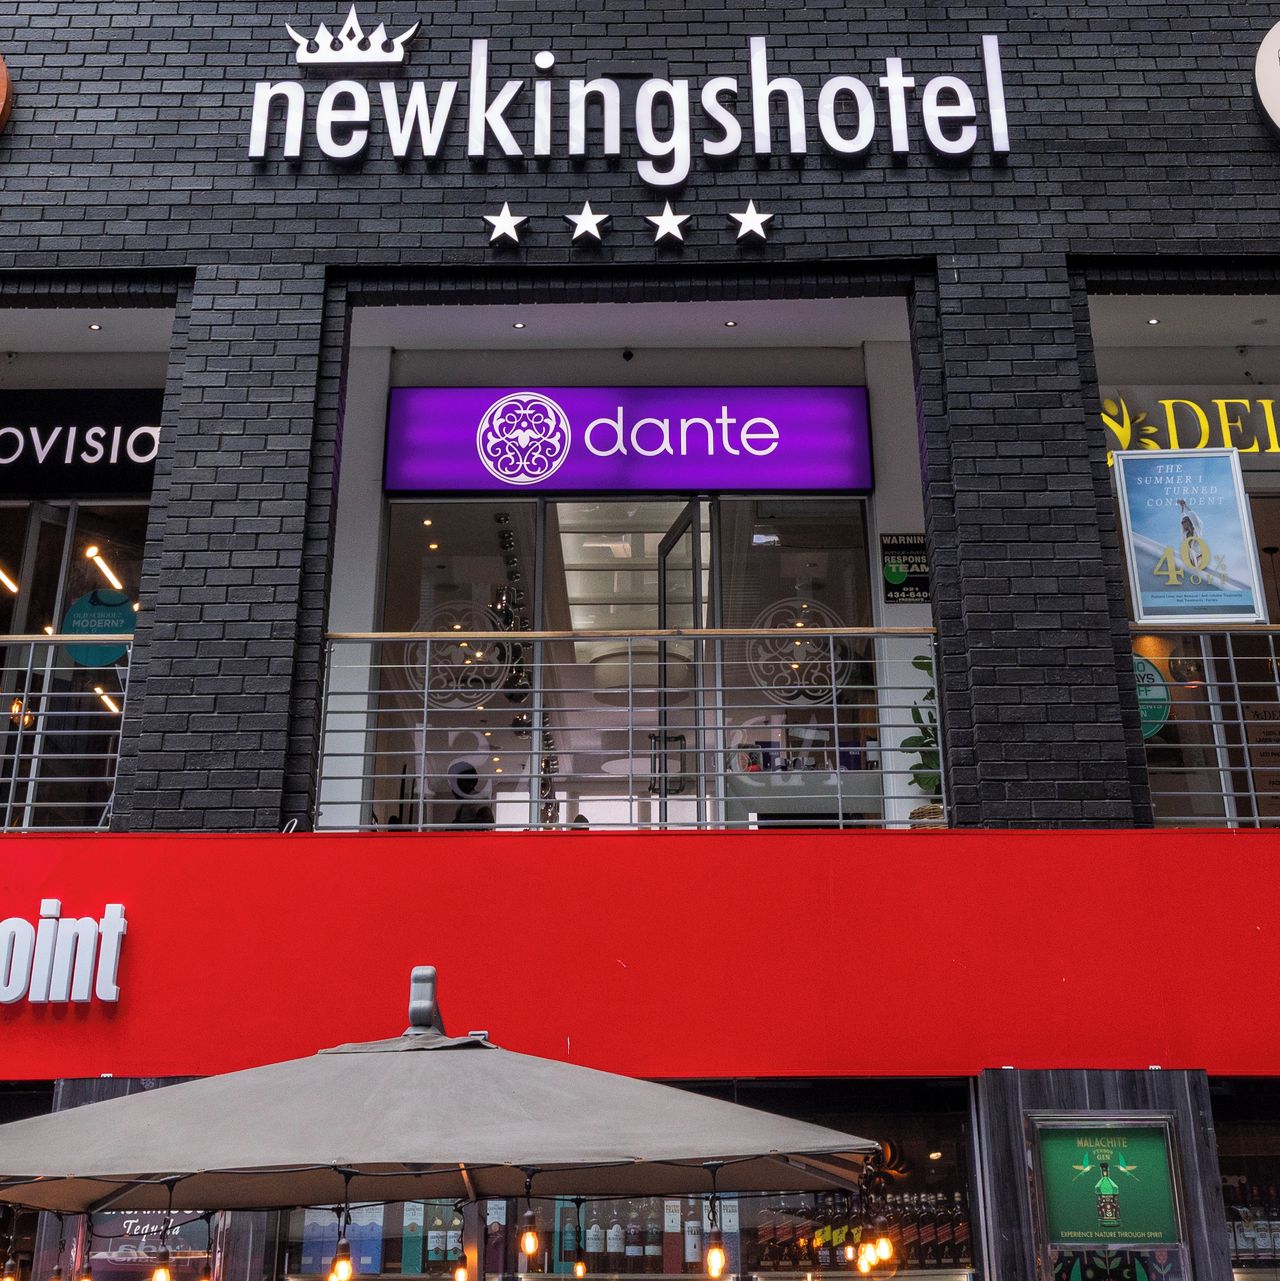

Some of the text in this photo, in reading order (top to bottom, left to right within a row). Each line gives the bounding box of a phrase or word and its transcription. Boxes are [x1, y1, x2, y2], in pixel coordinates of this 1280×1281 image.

[583, 405, 780, 457] dante
[1156, 464, 1183, 474] THE
[1136, 475, 1203, 485] SUMMER I
[1164, 486, 1218, 496] TURNED
[1146, 496, 1225, 507] CONDENT
[881, 536, 926, 545] WARNIN
[884, 555, 927, 563] RESPONS
[72, 620, 124, 628] MODERN?
[1077, 1137, 1128, 1148] MALACHITE
